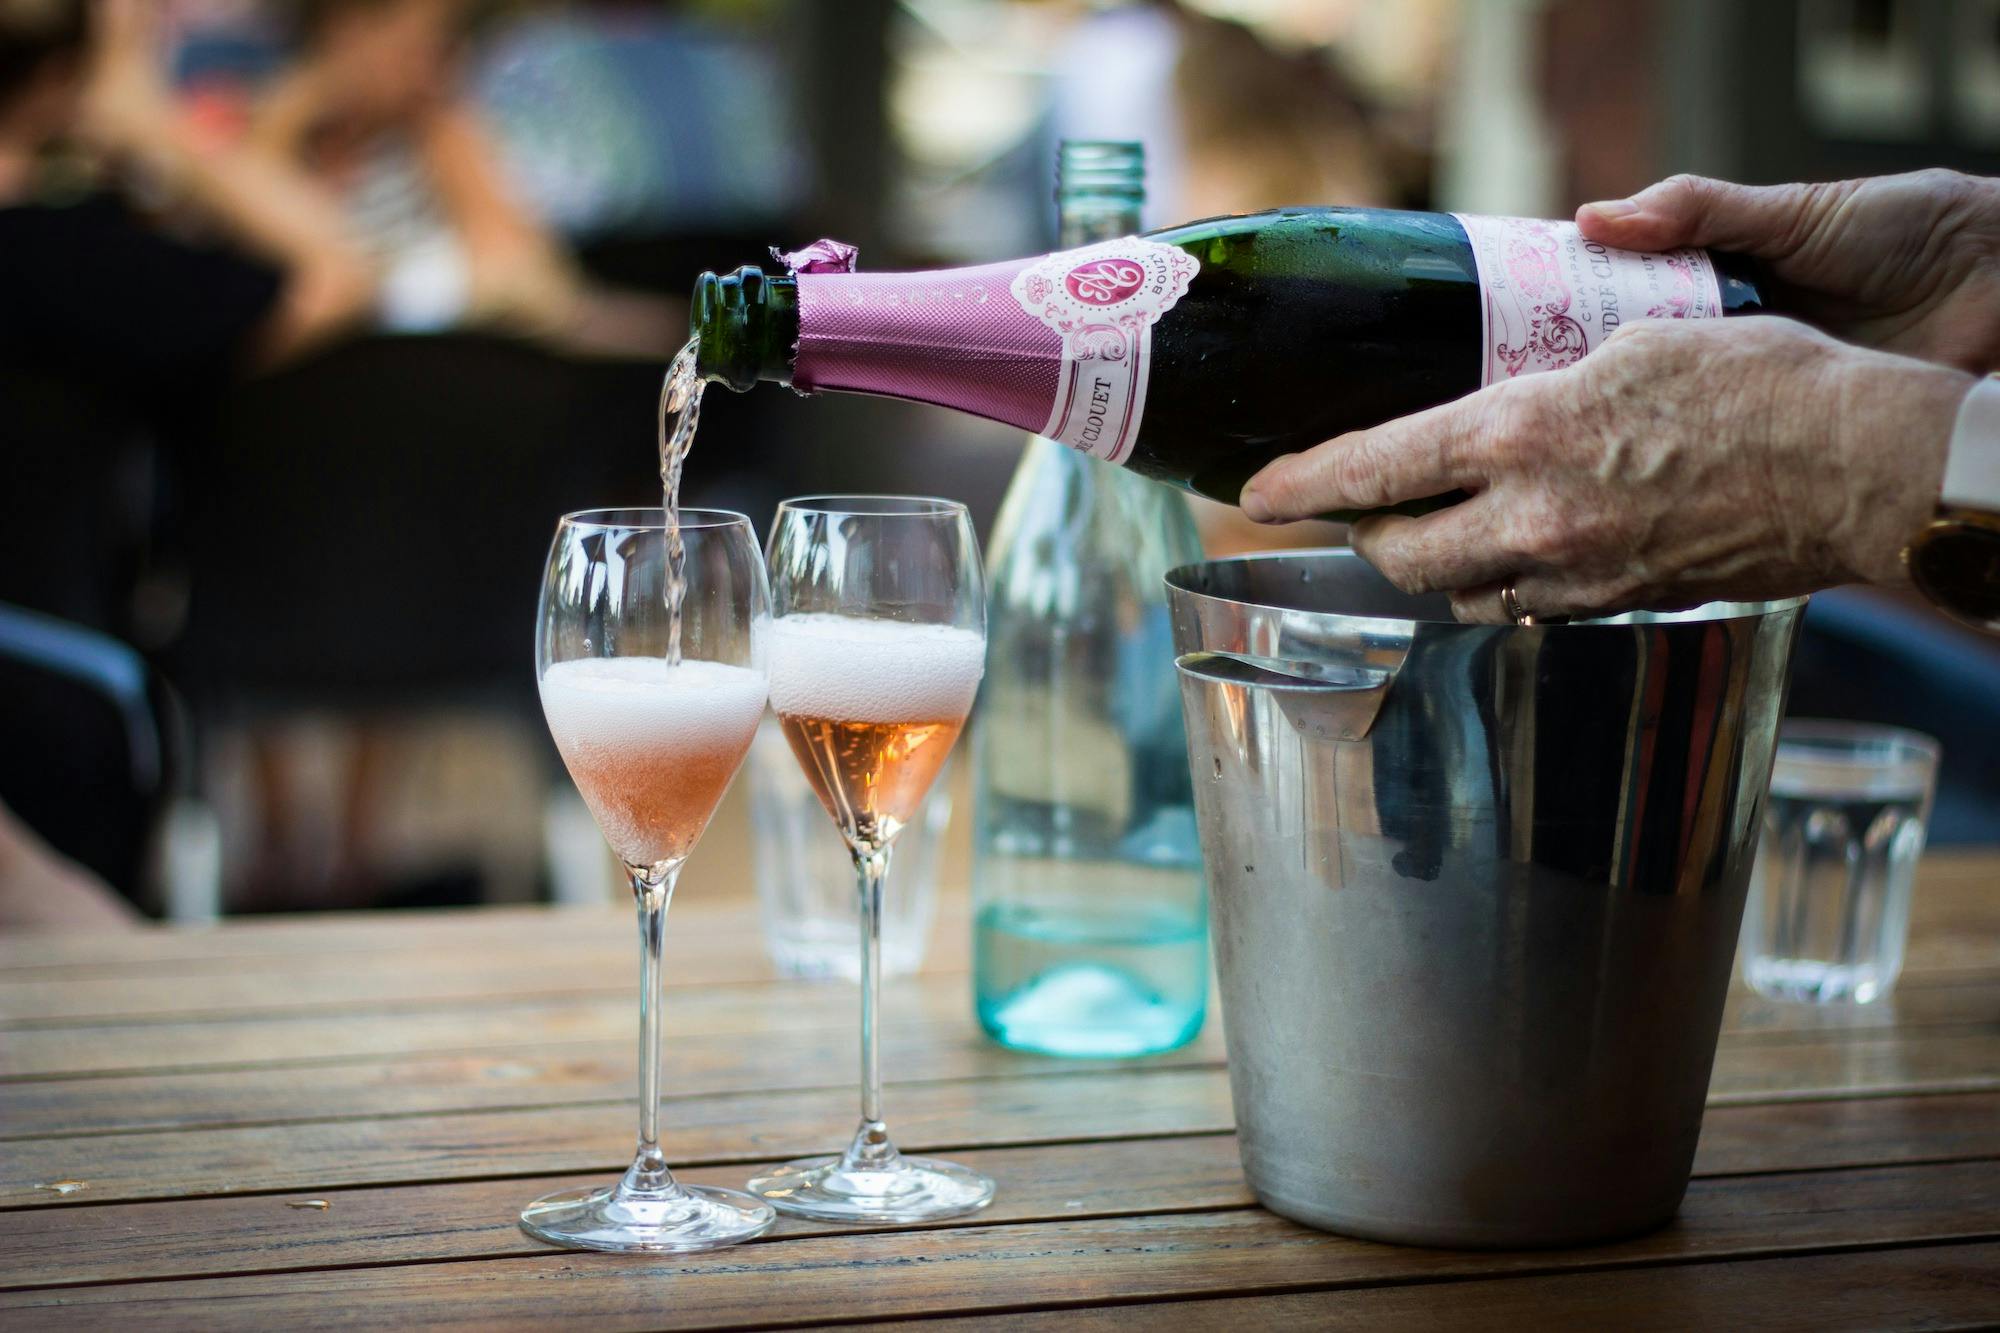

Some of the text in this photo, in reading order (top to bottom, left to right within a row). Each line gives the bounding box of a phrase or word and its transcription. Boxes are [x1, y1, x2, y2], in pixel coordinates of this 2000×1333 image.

[1147, 252, 1168, 296] BOUZY
[1640, 254, 1659, 292] BRUT
[1081, 377, 1112, 441] CLOUET
